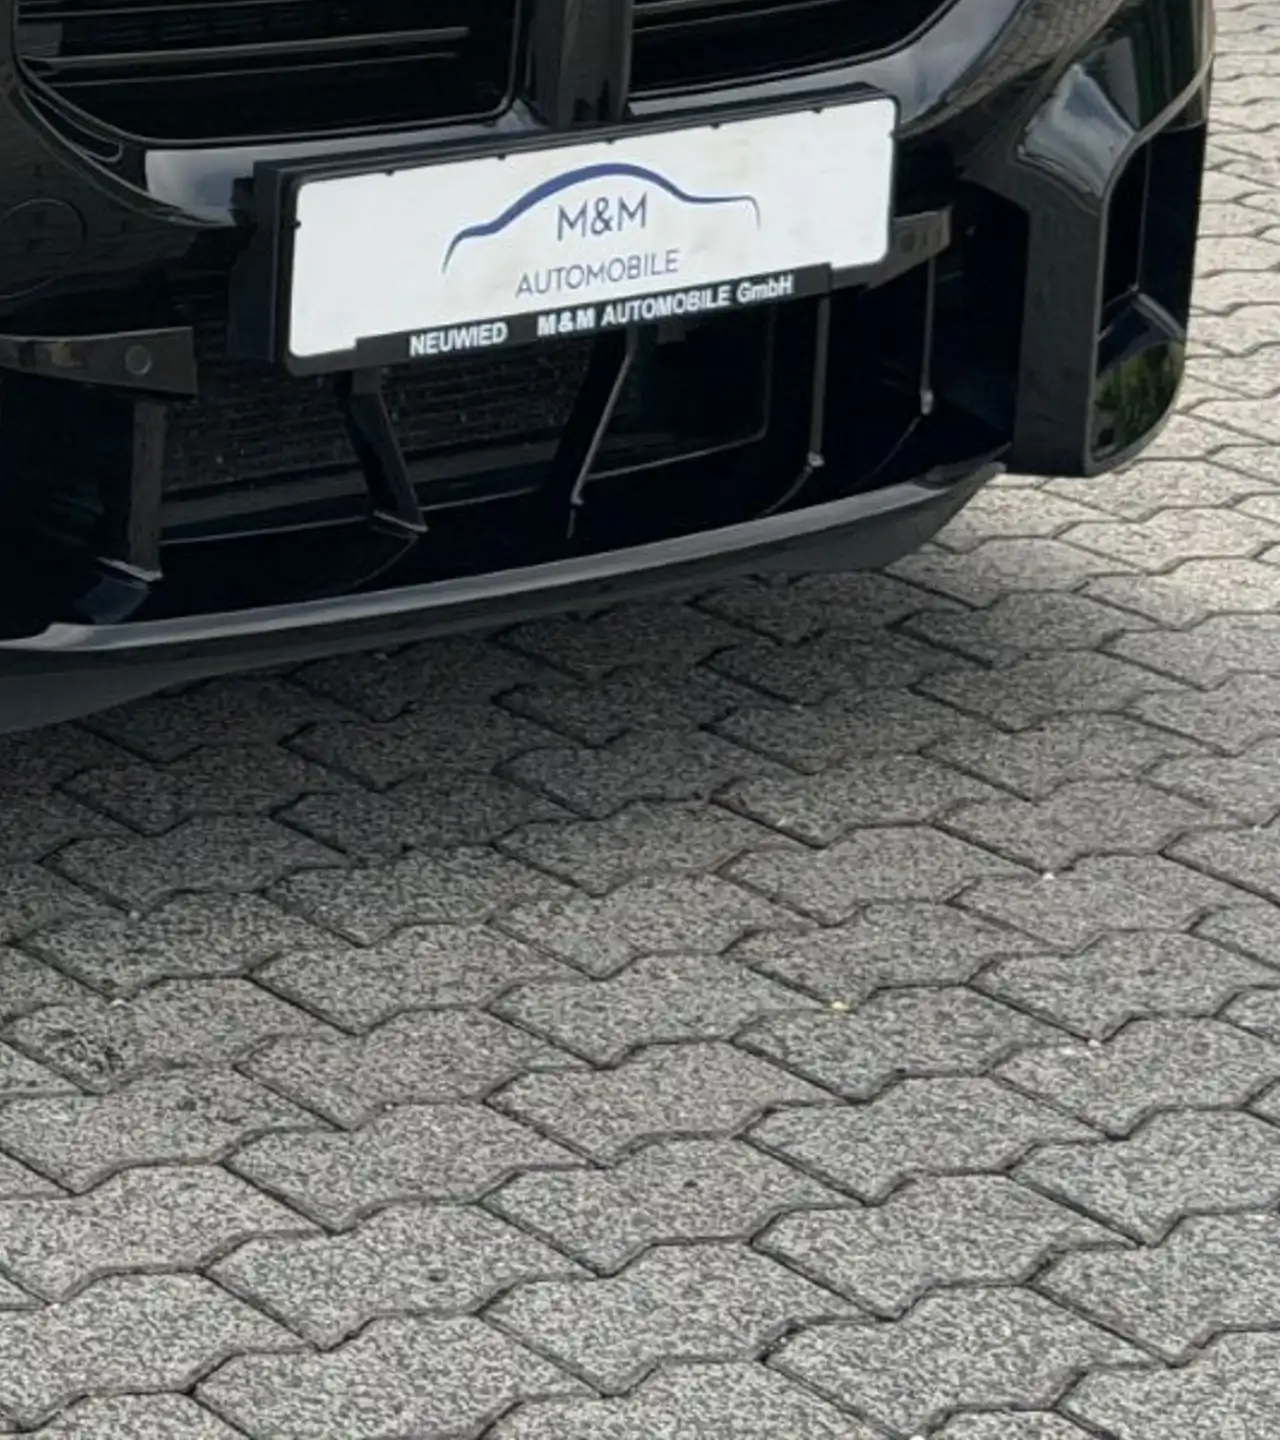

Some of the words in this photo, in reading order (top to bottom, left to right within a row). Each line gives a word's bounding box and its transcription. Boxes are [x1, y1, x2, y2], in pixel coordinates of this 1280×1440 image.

[556, 191, 647, 242] M&M
[514, 248, 680, 298] AUTOMOBILE
[409, 321, 509, 357] NEUWIED
[537, 307, 597, 337] M&M
[600, 284, 732, 327] AUTOMOBILE
[736, 273, 795, 304] GmbH
